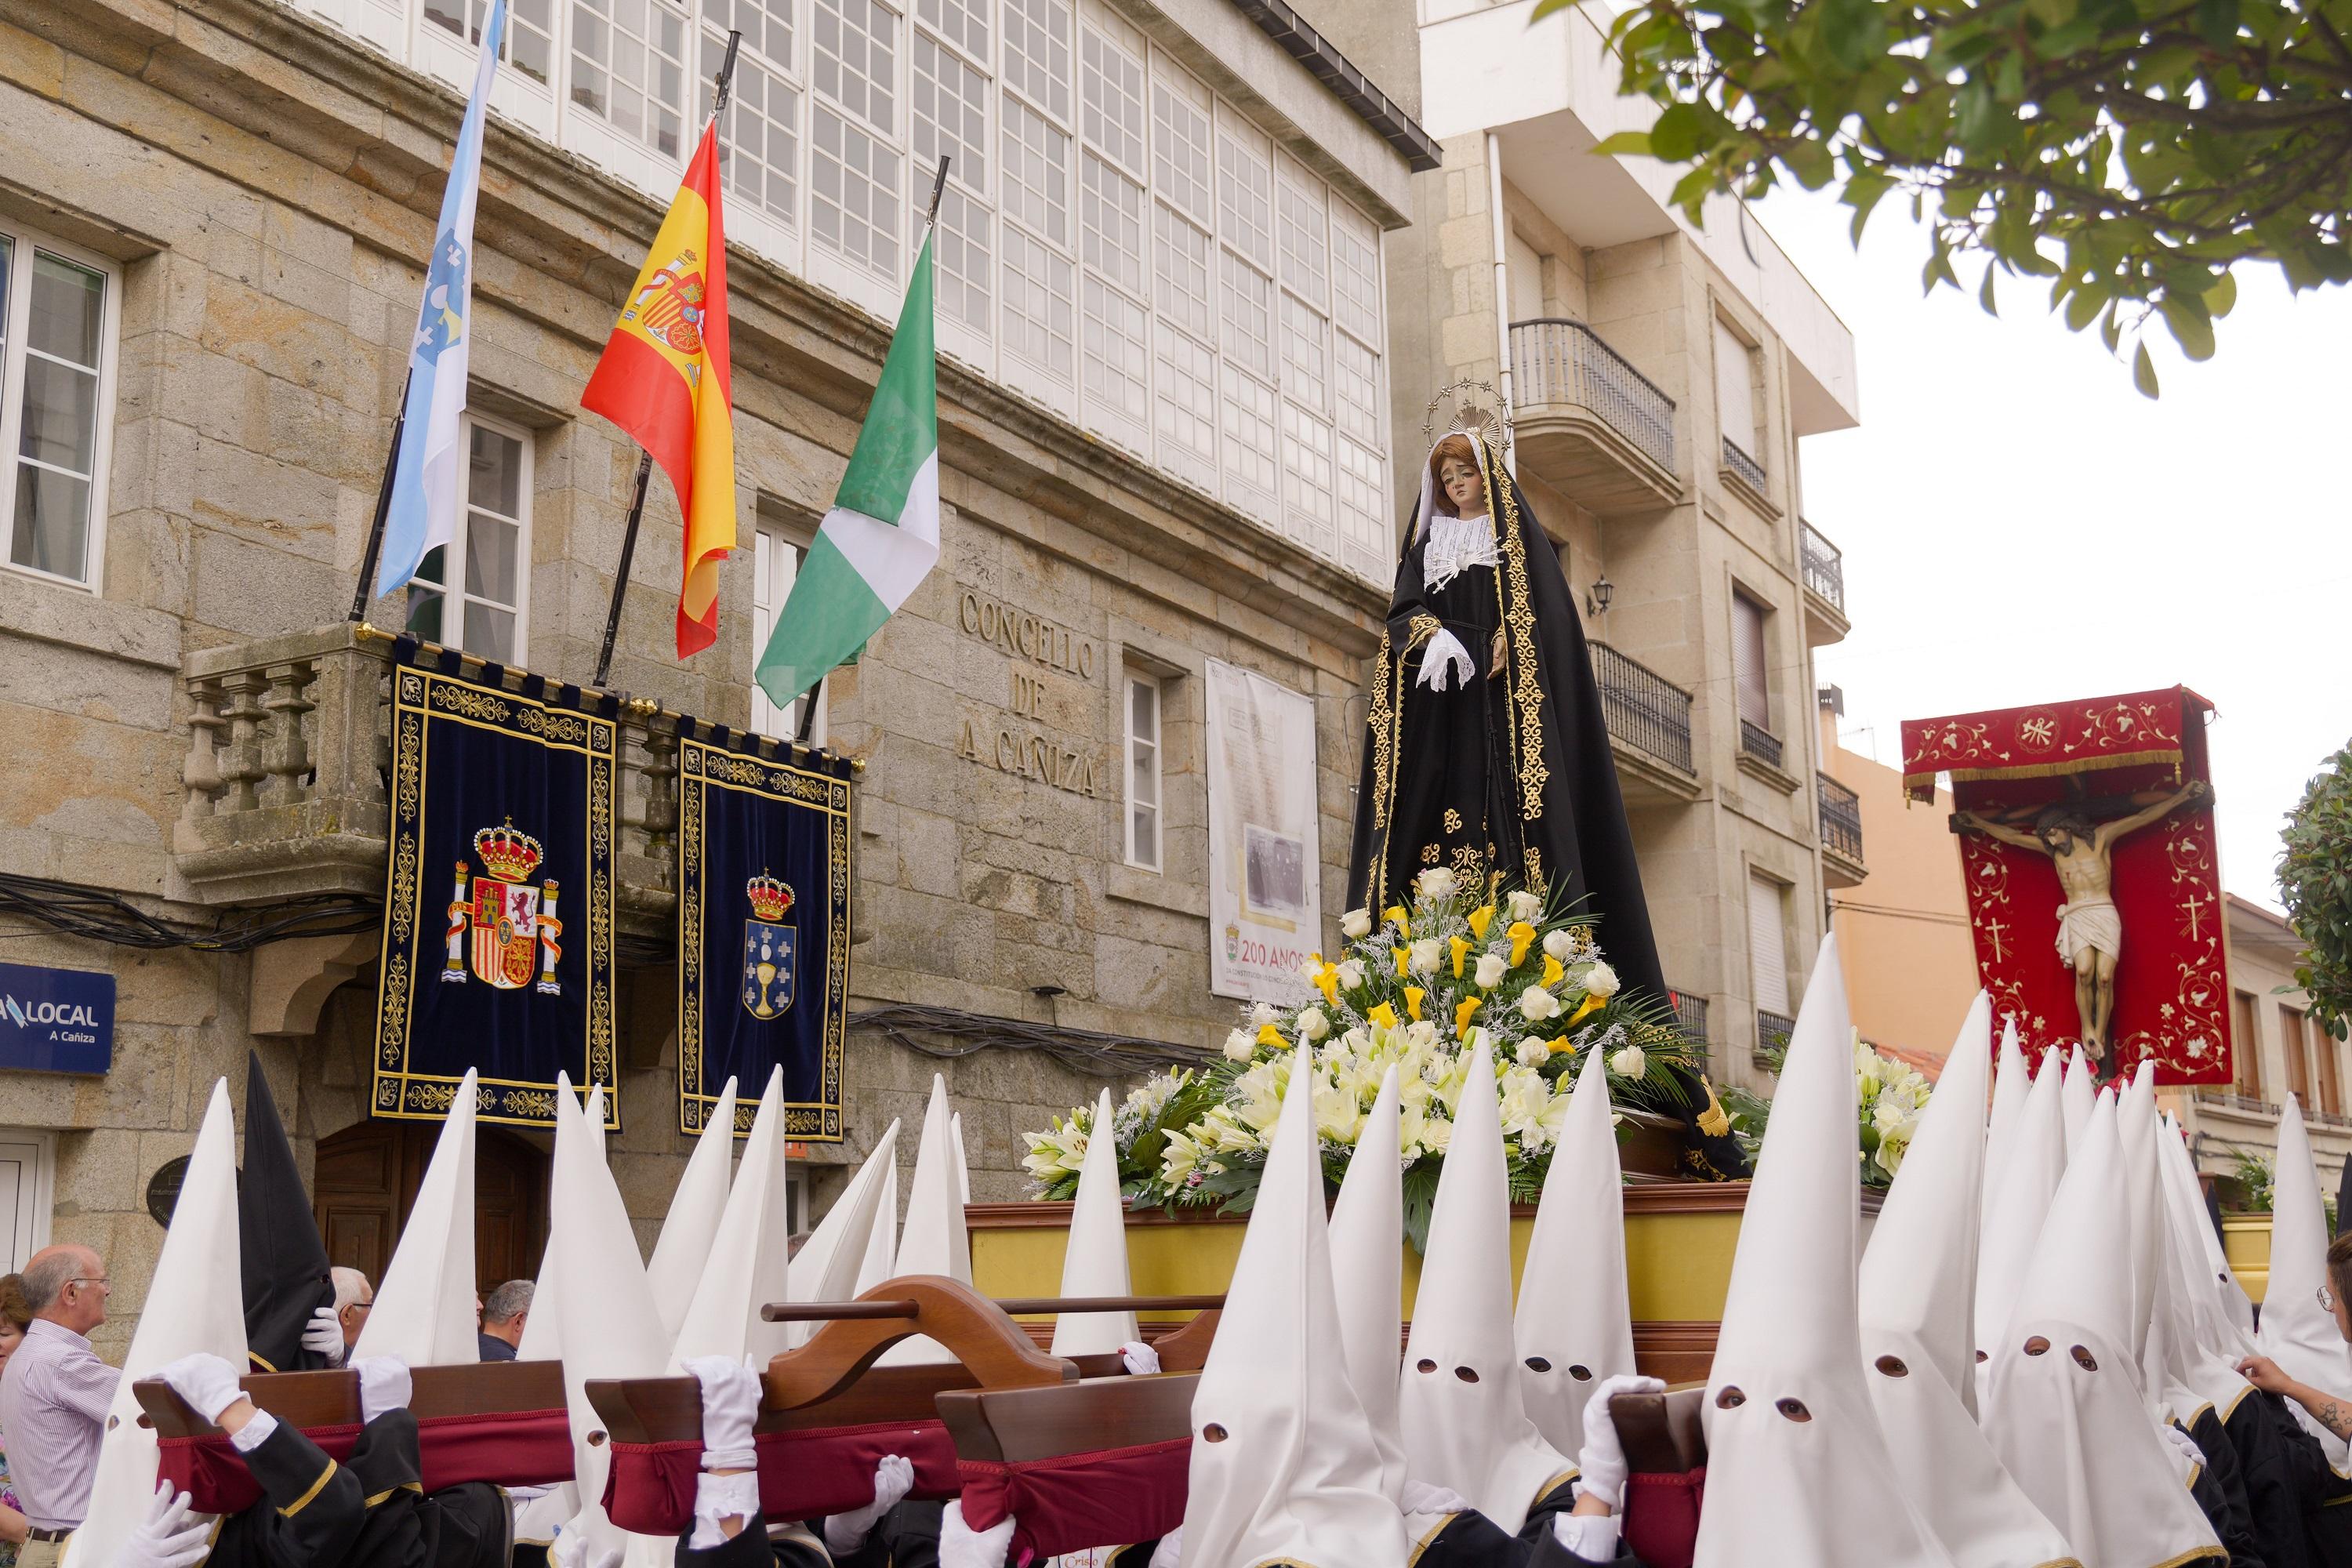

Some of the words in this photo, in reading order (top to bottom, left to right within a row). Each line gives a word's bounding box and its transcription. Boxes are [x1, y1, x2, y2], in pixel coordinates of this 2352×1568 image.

[960, 593, 1093, 679] CONCELLO
[1014, 673, 1045, 720] DE
[959, 720, 978, 762] A
[996, 729, 1095, 798] CAÑIZA
[1242, 940, 1266, 966] 200
[1269, 947, 1304, 973] ANOS
[26, 1001, 99, 1027] LOCAL
[49, 1030, 58, 1041] A
[61, 1031, 96, 1044] Cañiza
[1065, 1555, 1098, 1568] Criso
